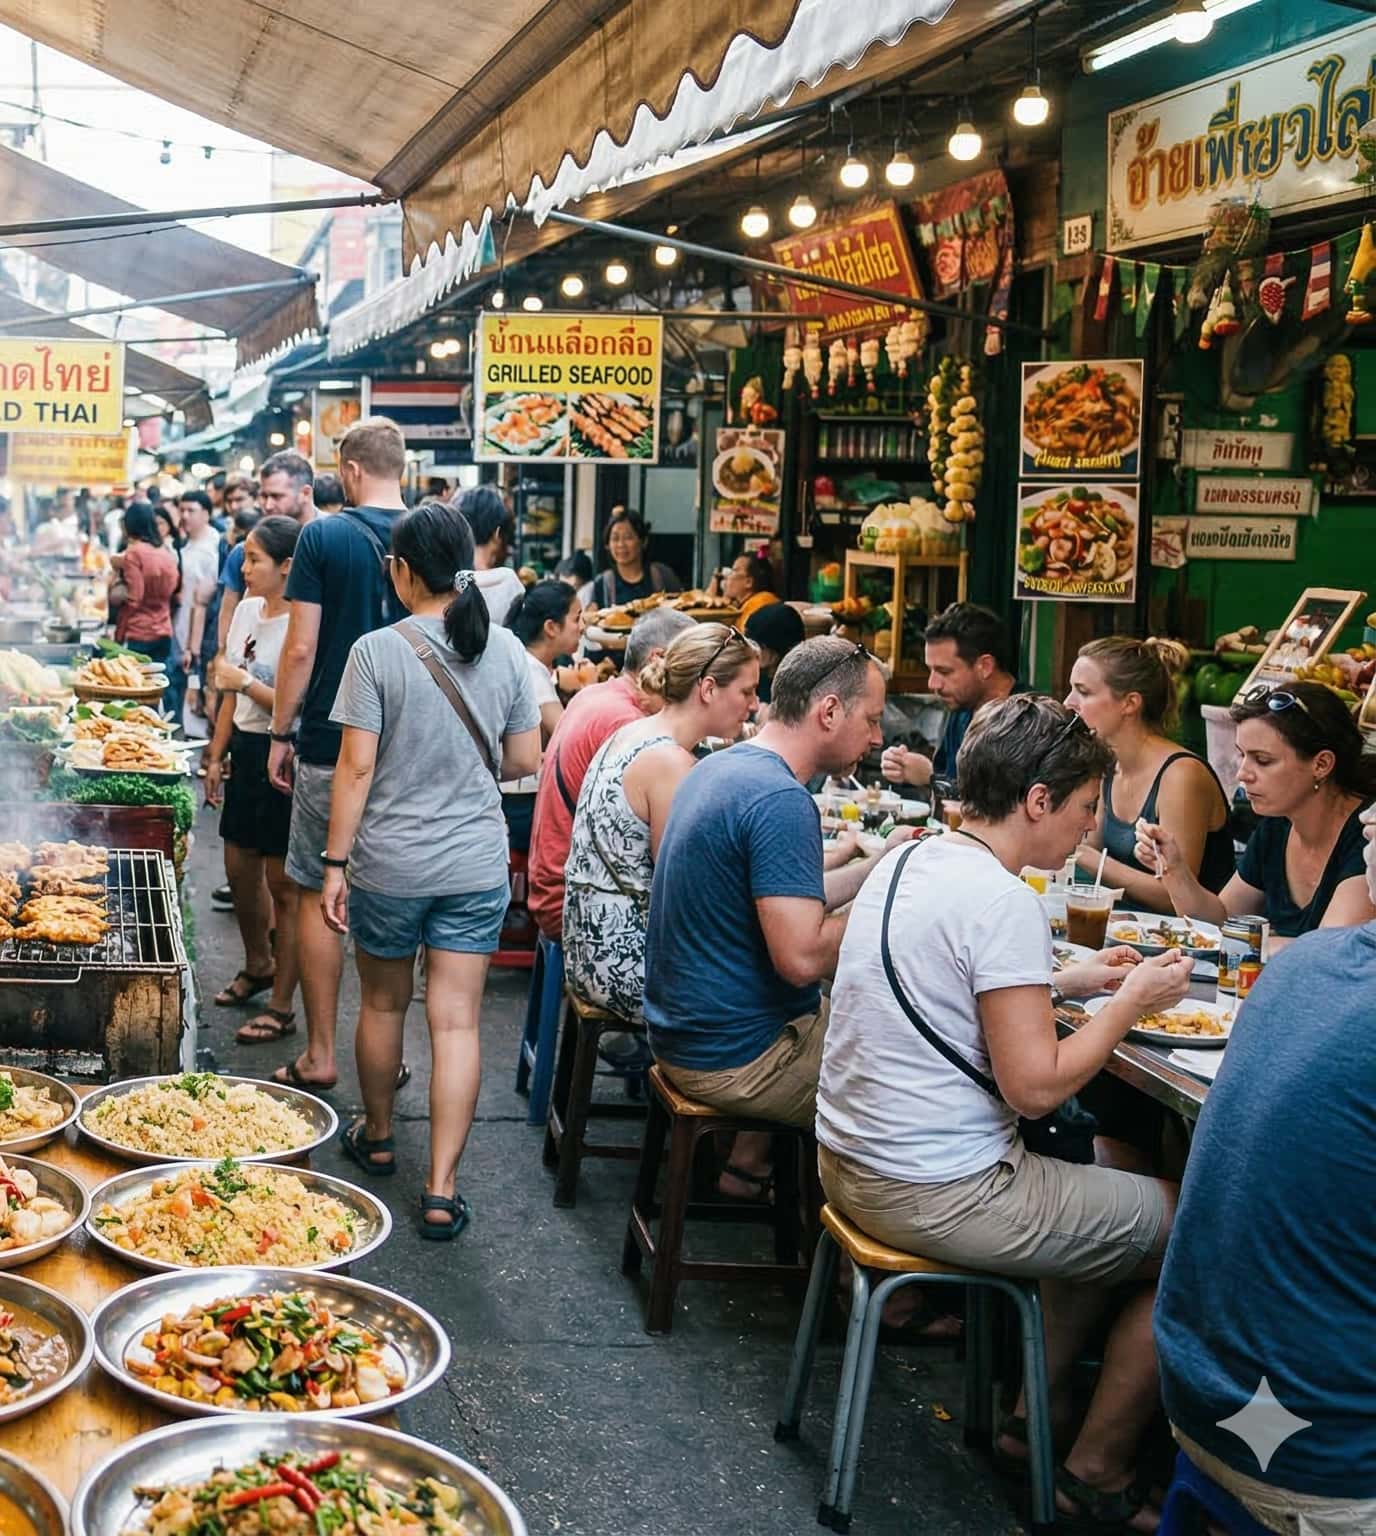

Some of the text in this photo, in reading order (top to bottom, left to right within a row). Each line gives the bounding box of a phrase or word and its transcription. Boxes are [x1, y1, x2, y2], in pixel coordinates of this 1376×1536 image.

[487, 363, 653, 386] GRILLED SEAFOOD
[33, 402, 97, 424] THAI
